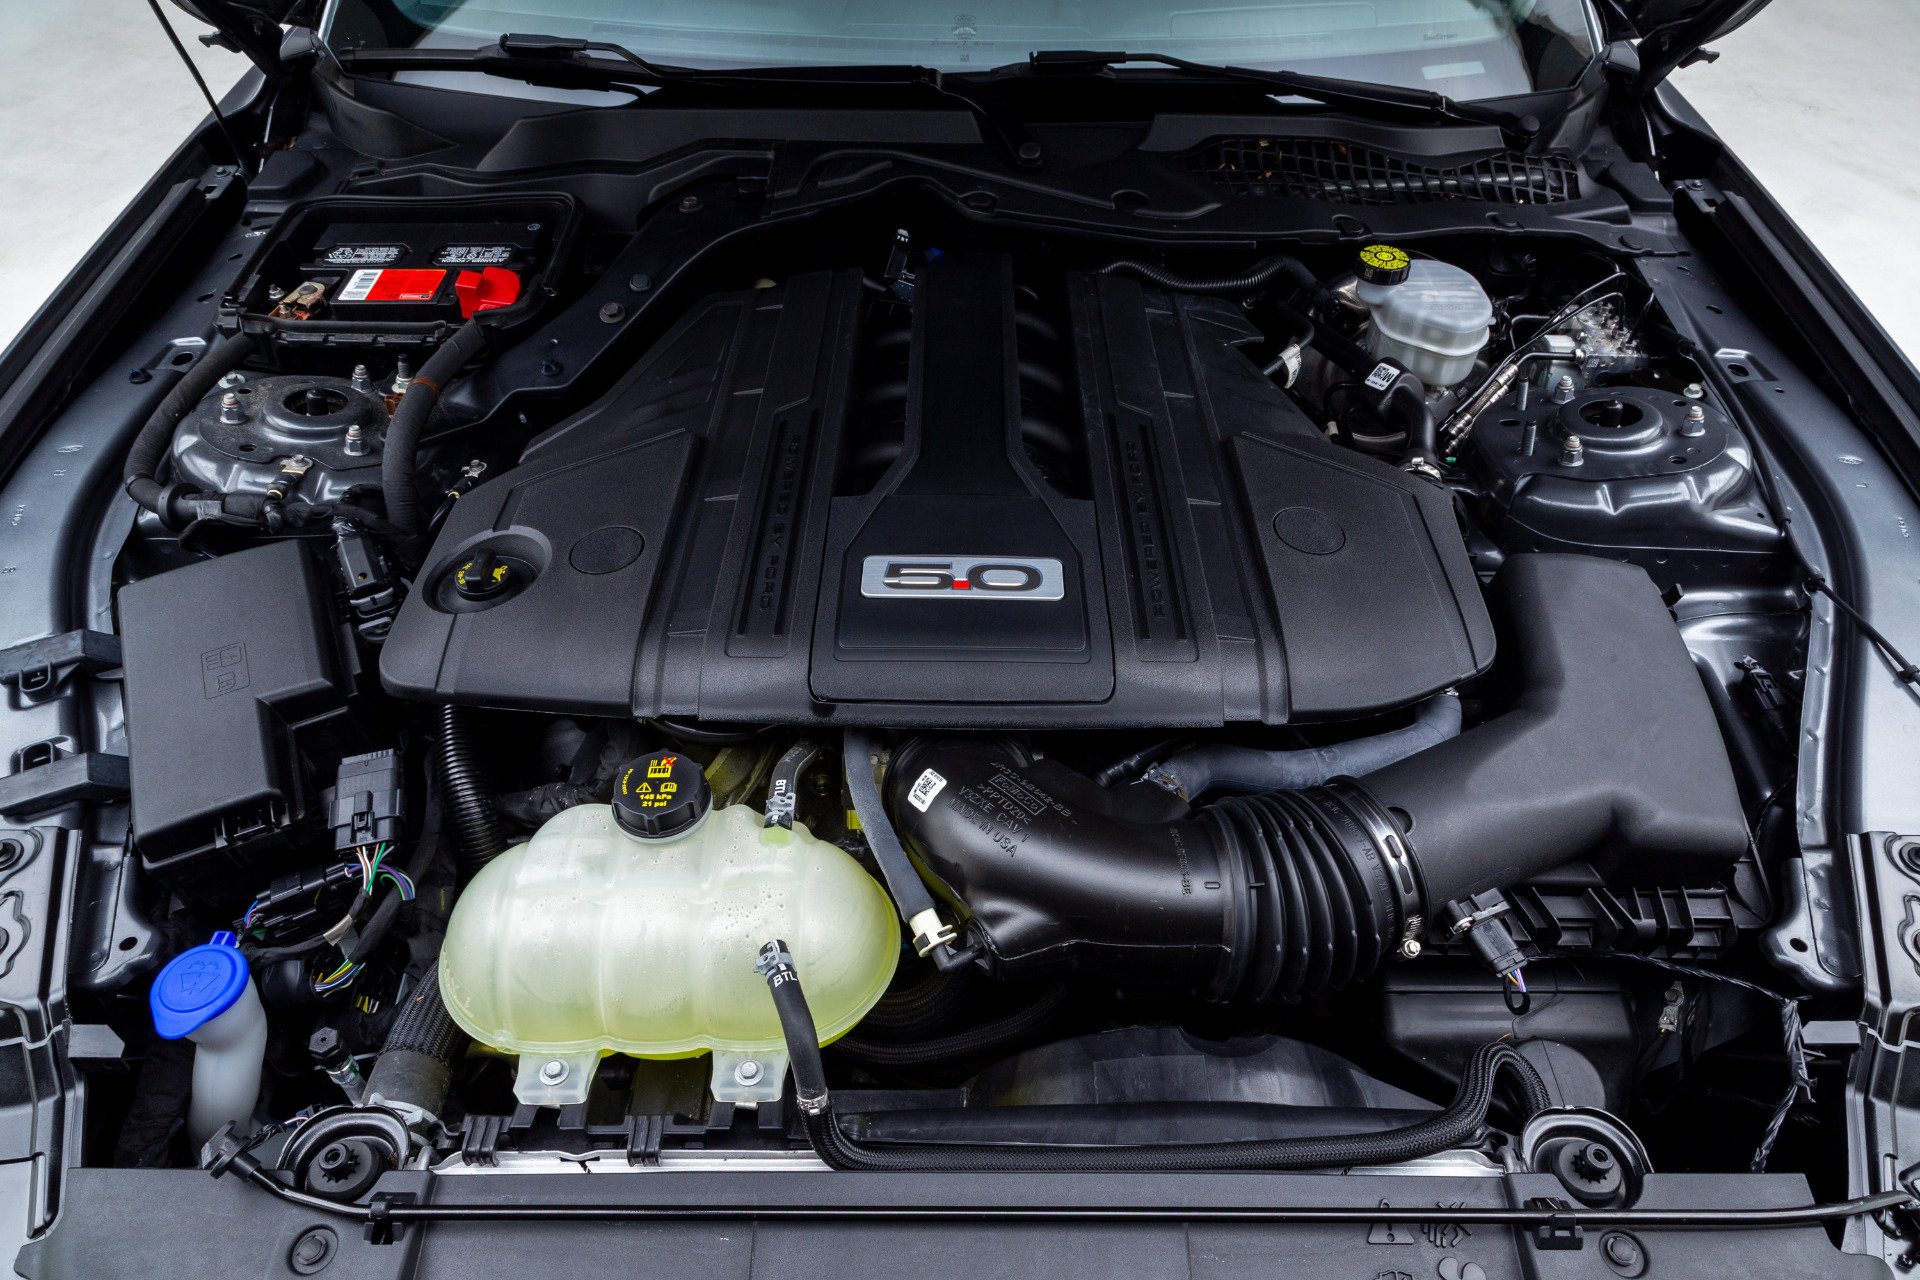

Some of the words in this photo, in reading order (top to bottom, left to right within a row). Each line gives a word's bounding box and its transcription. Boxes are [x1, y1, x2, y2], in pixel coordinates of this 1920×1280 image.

[882, 560, 1044, 591] 5.0
[774, 779, 787, 796] BTL
[994, 776, 1039, 810] FoMoCo
[654, 800, 667, 808] psi
[946, 797, 980, 825] MADE
[978, 819, 995, 835] IN
[993, 831, 1016, 858] USA
[995, 812, 1023, 833] CAV
[772, 971, 798, 988] BTL
